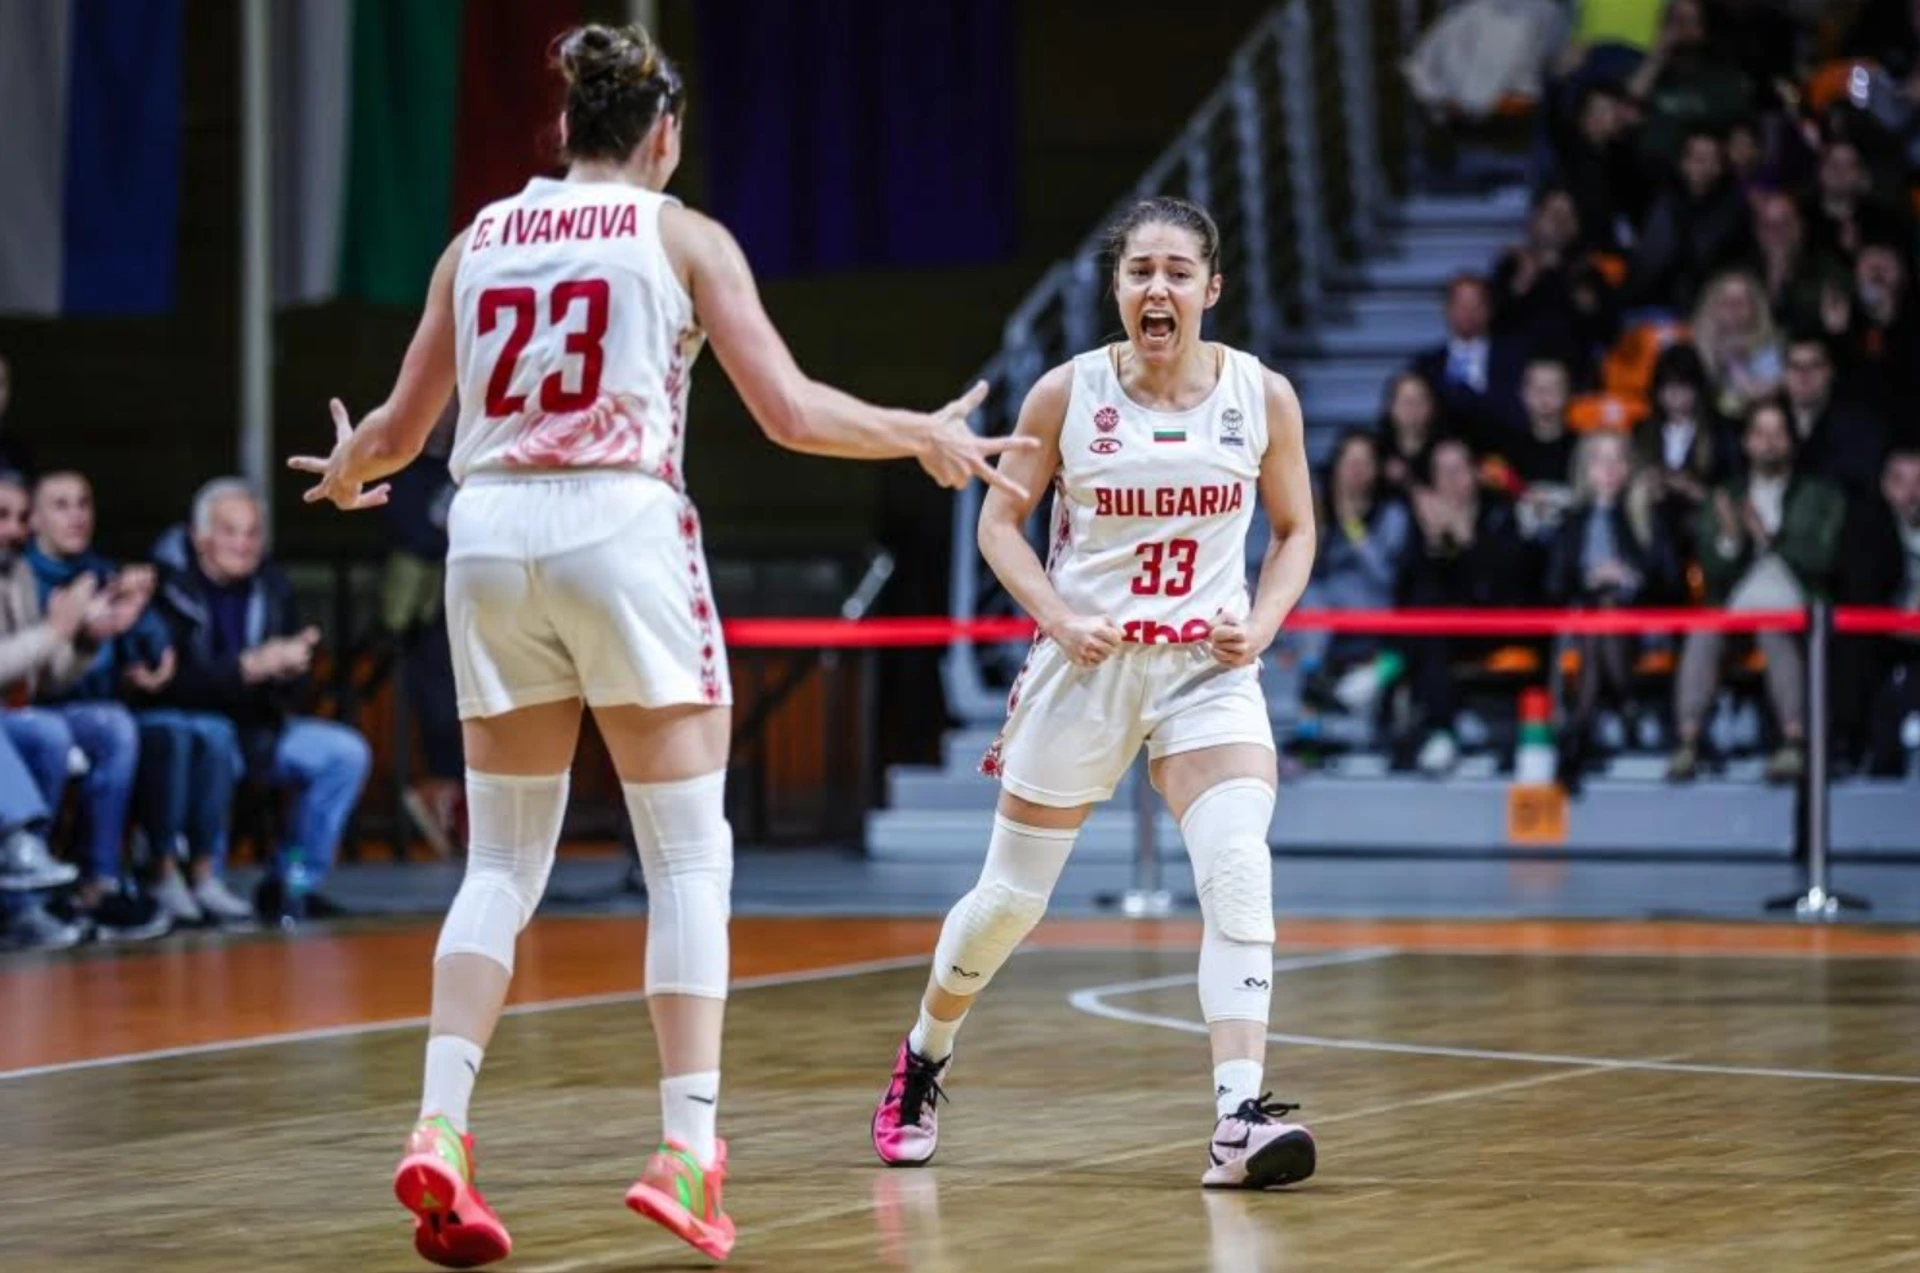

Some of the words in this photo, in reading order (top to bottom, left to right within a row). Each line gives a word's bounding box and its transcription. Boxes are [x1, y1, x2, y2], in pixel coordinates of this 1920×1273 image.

[502, 205, 637, 246] IVANOVA
[477, 279, 609, 418] 23
[1095, 483, 1242, 517] BULGARIA
[1131, 538, 1198, 597] 33
